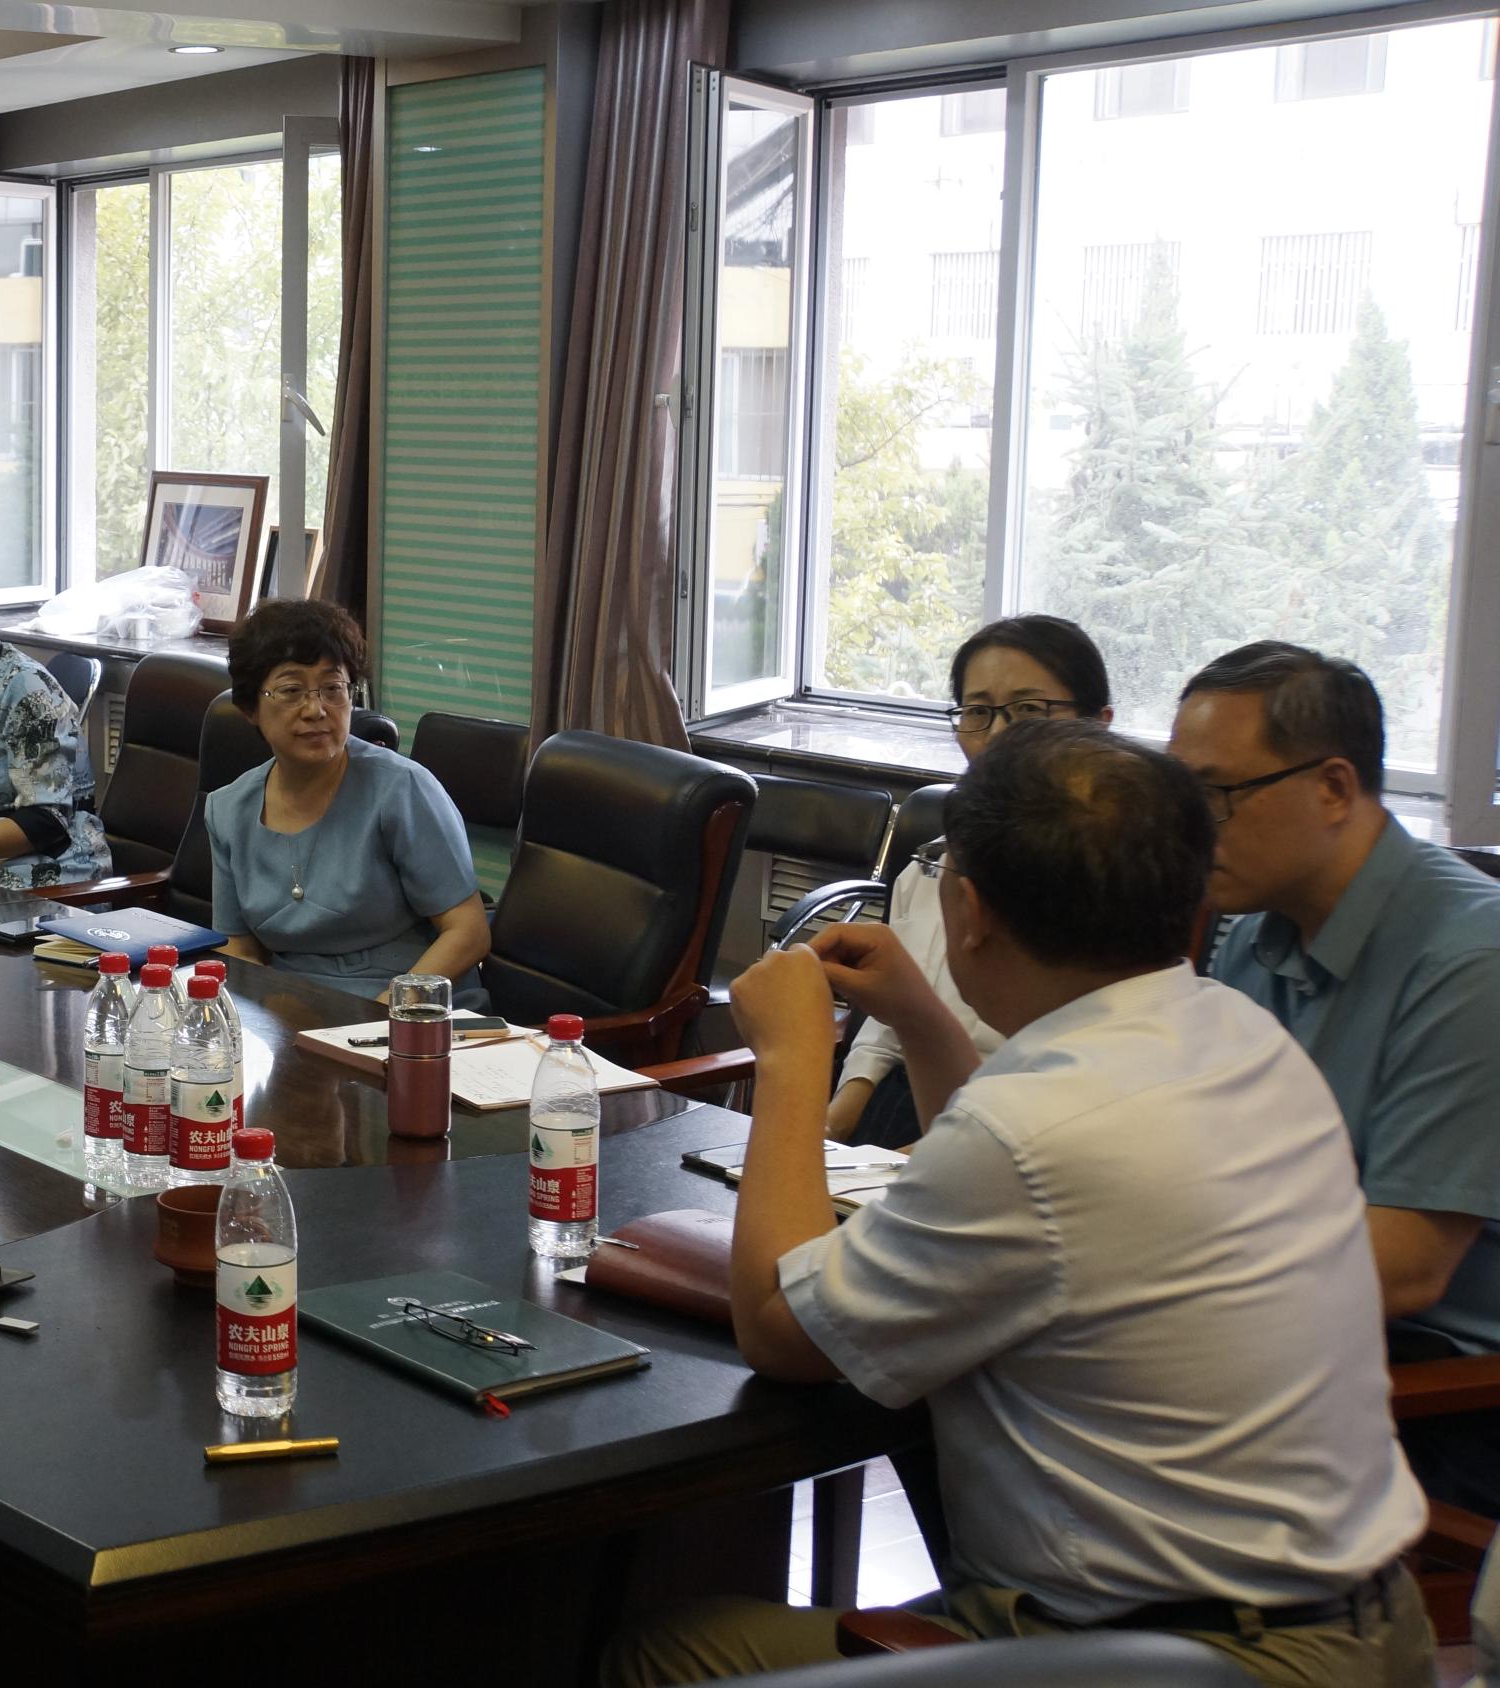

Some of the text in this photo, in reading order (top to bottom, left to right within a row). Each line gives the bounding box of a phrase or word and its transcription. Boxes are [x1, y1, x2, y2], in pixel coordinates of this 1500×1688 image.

[188, 1144, 215, 1153] NONGFU
[228, 1323, 289, 1343] 农夫山泉
[228, 1340, 289, 1354] NONGFU SPRING
